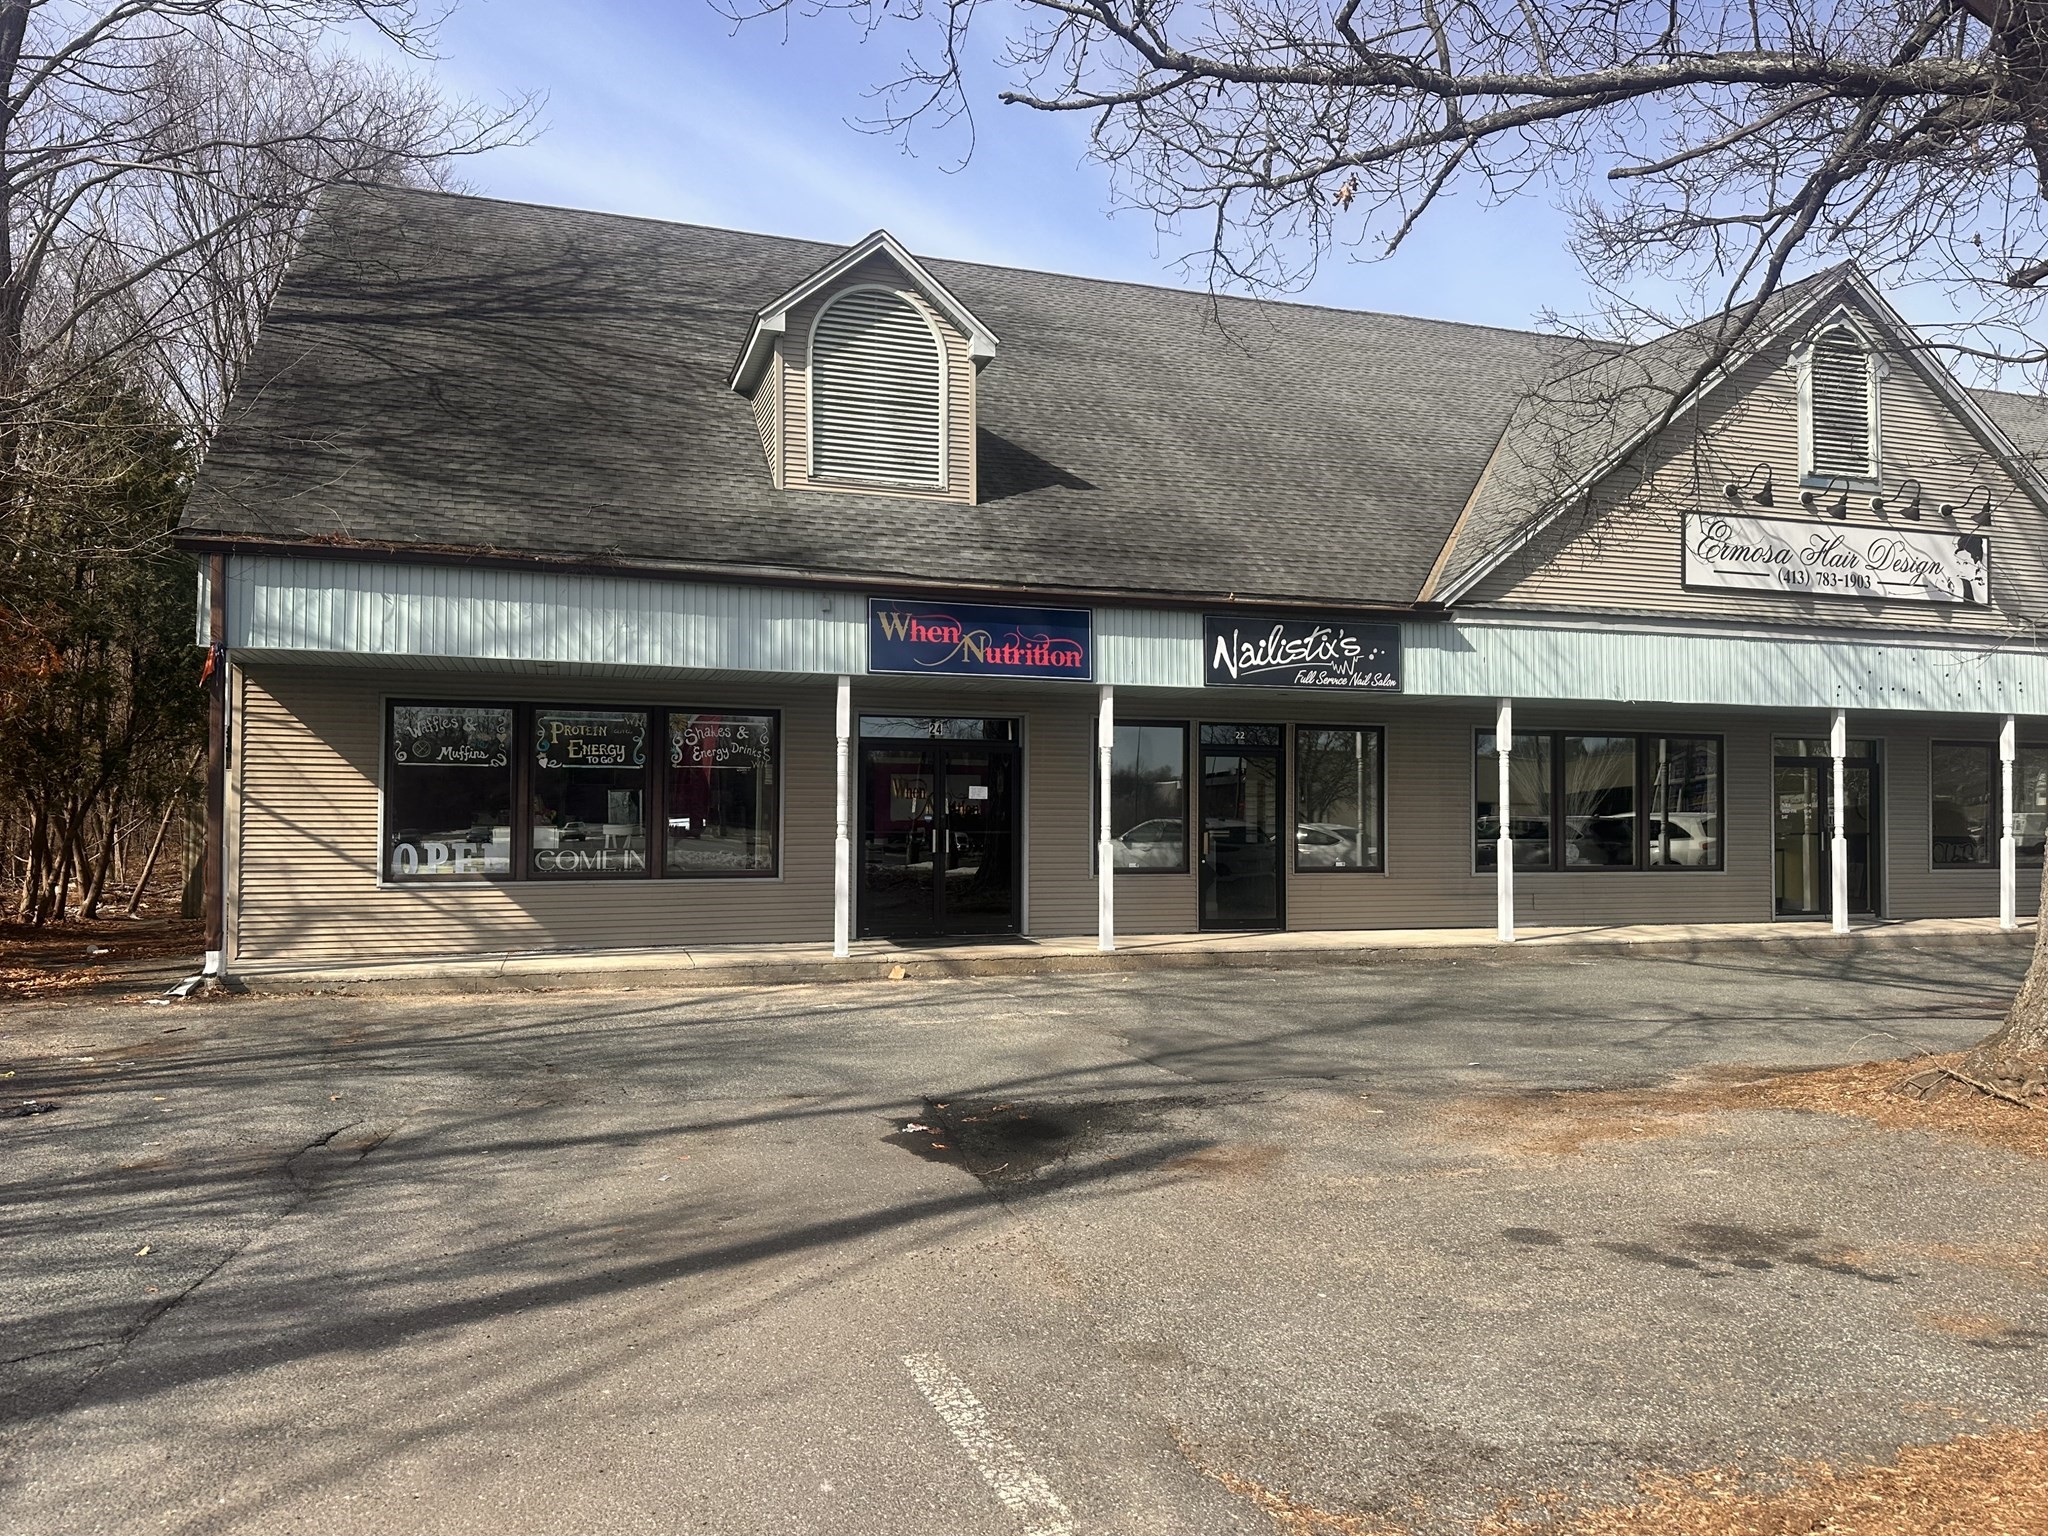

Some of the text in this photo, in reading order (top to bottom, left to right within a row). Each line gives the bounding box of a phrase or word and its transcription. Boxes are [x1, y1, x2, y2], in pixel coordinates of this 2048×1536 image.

[1799, 533, 1861, 570] Hair
[1865, 537, 1944, 586] Design
[1777, 569, 1871, 589] (413) 783-1903
[877, 608, 1084, 668] When Nutrition
[1294, 670, 1397, 687] Full Service Nail Salon
[406, 716, 458, 738] Waffles
[463, 717, 478, 731] &
[684, 725, 749, 746] Shakes &
[929, 723, 942, 735] 24
[1235, 731, 1246, 739] 22
[436, 745, 489, 761] Muffins
[586, 756, 614, 764] TO GO
[693, 742, 762, 762] Energy Drinks
[534, 849, 646, 872] COME IN
